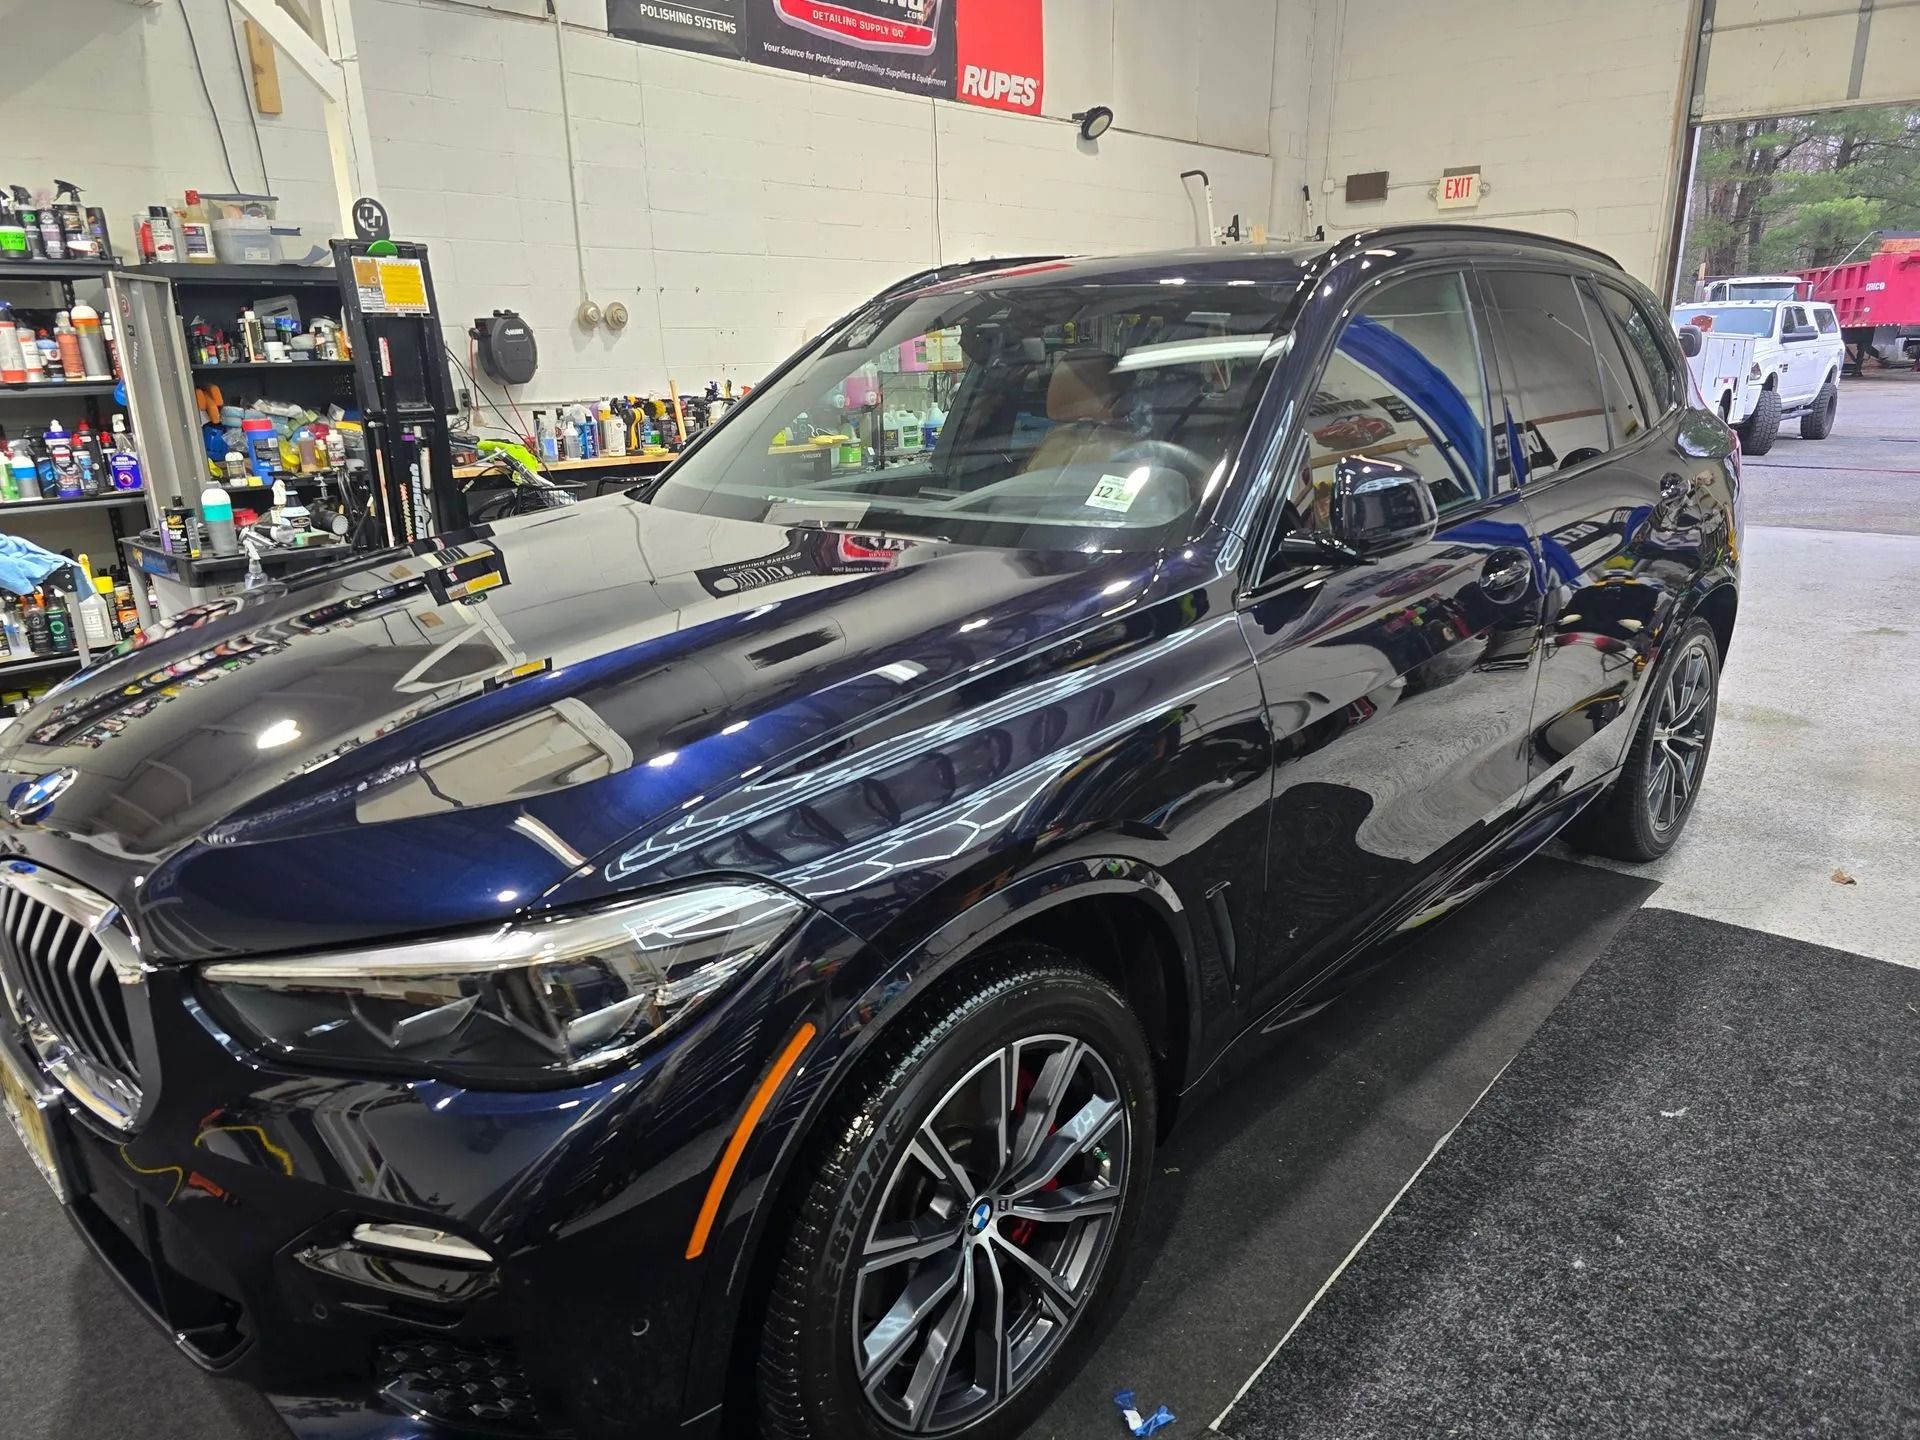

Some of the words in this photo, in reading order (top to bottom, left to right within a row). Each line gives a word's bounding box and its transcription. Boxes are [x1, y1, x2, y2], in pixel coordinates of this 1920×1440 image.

[640, 3, 693, 25] POLISHING
[695, 15, 737, 35] SYSTEMS
[812, 9, 857, 28] DETAILING
[859, 21, 889, 35] SUPPLY
[763, 41, 780, 52] Your
[781, 45, 805, 58] Source
[805, 50, 815, 60] for
[815, 53, 857, 69] Professional
[857, 61, 885, 76] Detailing
[885, 67, 911, 80] Supplies
[962, 64, 1037, 107] RUPES
[1445, 176, 1473, 199] EXIT
[1095, 485, 1113, 499] 12
